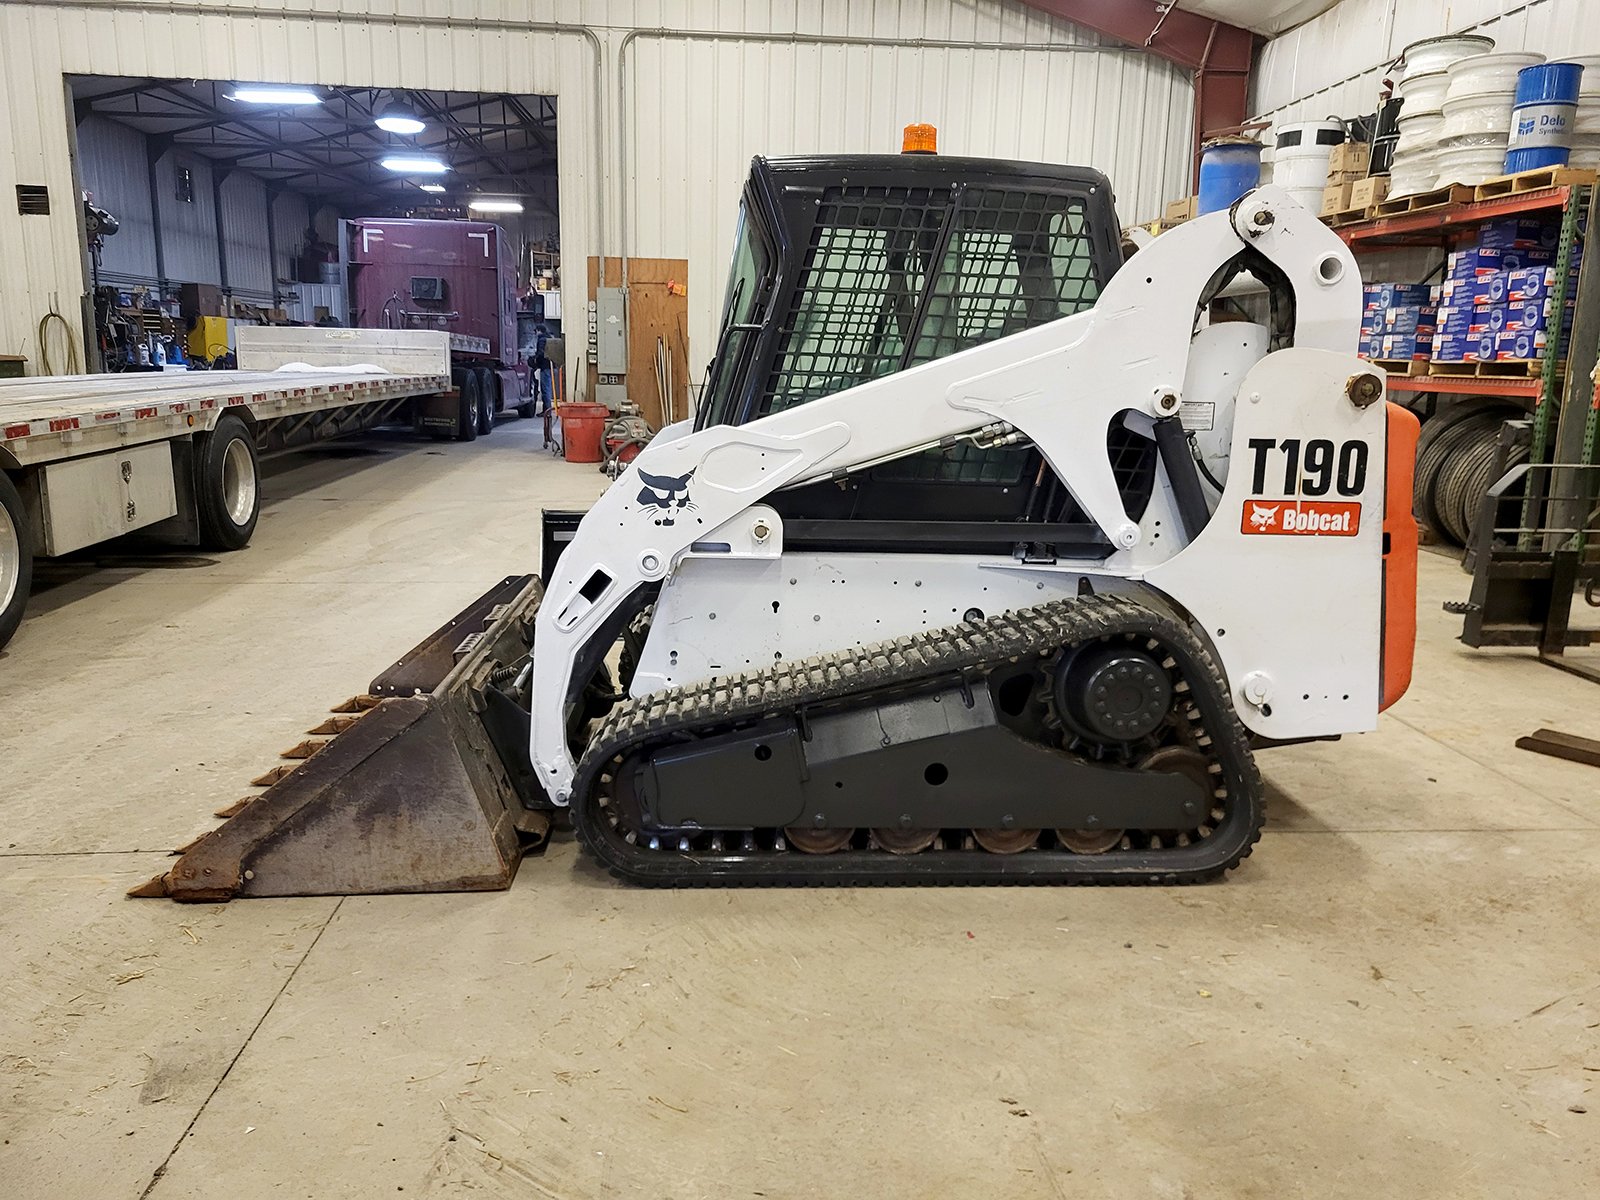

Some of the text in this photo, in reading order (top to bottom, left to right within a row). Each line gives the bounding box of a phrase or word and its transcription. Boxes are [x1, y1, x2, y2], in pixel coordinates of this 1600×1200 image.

[1540, 114, 1566, 126] Delo
[1538, 127, 1569, 136] Synthe
[1248, 438, 1369, 496] T190
[1282, 508, 1351, 532] Bobcat
